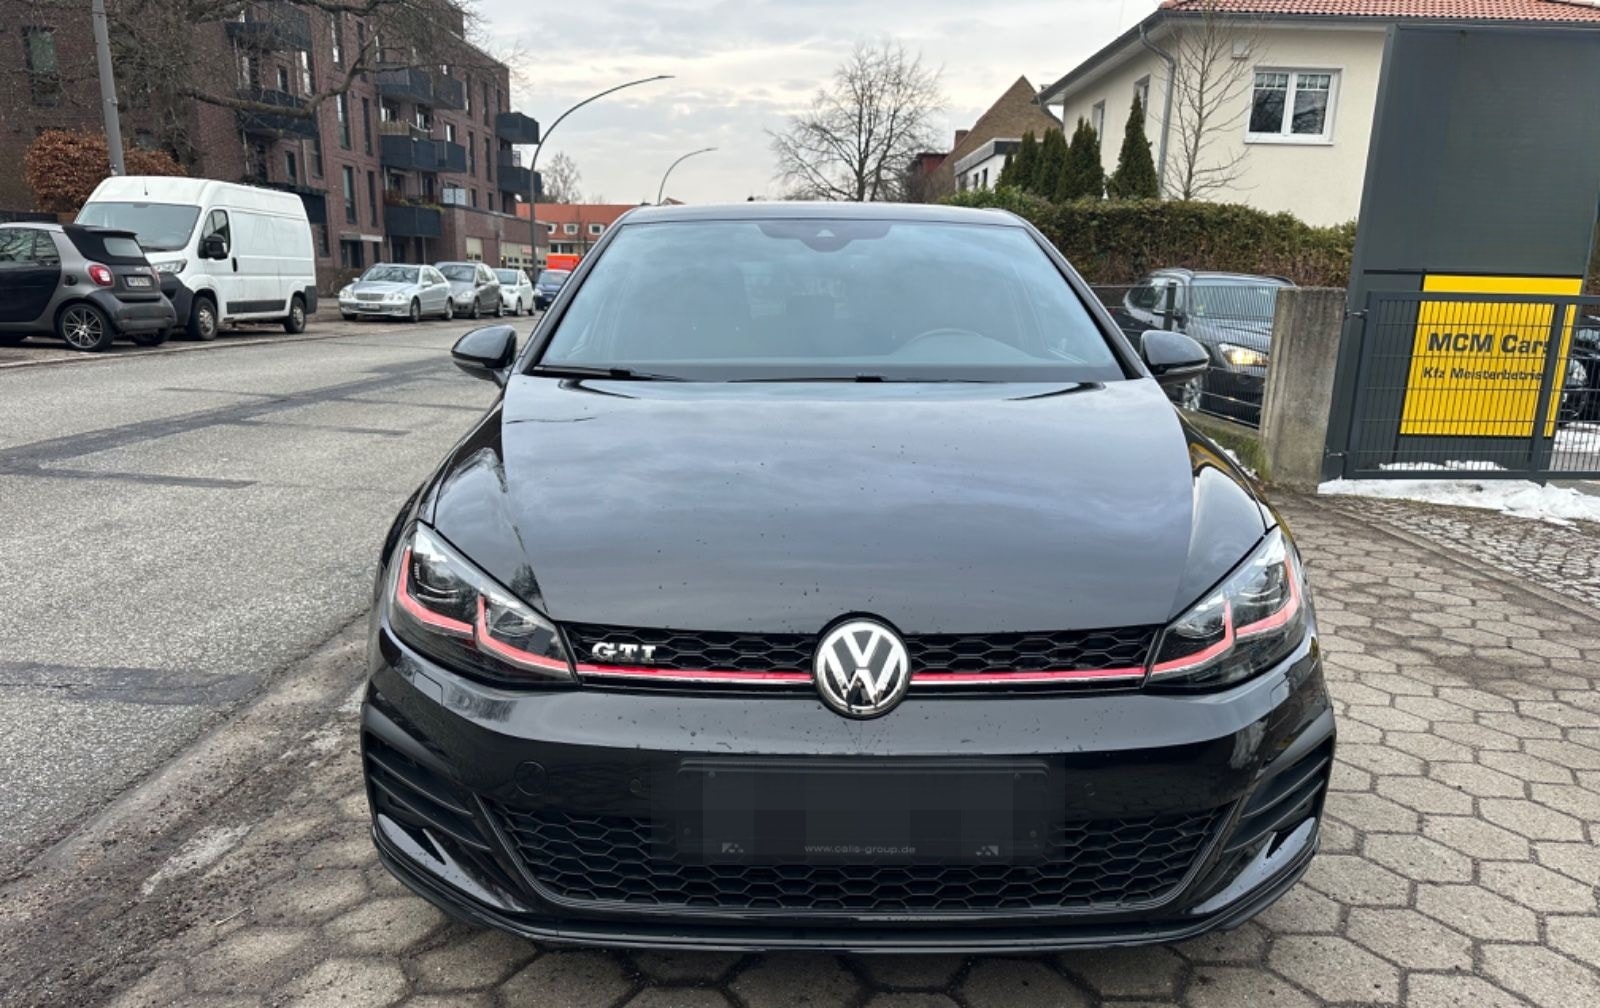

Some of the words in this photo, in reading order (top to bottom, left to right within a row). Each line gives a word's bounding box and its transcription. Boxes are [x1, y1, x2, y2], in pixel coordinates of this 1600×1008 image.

[1427, 332, 1494, 353] MCM
[1422, 367, 1445, 379] Kfz
[1450, 367, 1544, 381] Meisterbetrie
[590, 641, 657, 663] GTI
